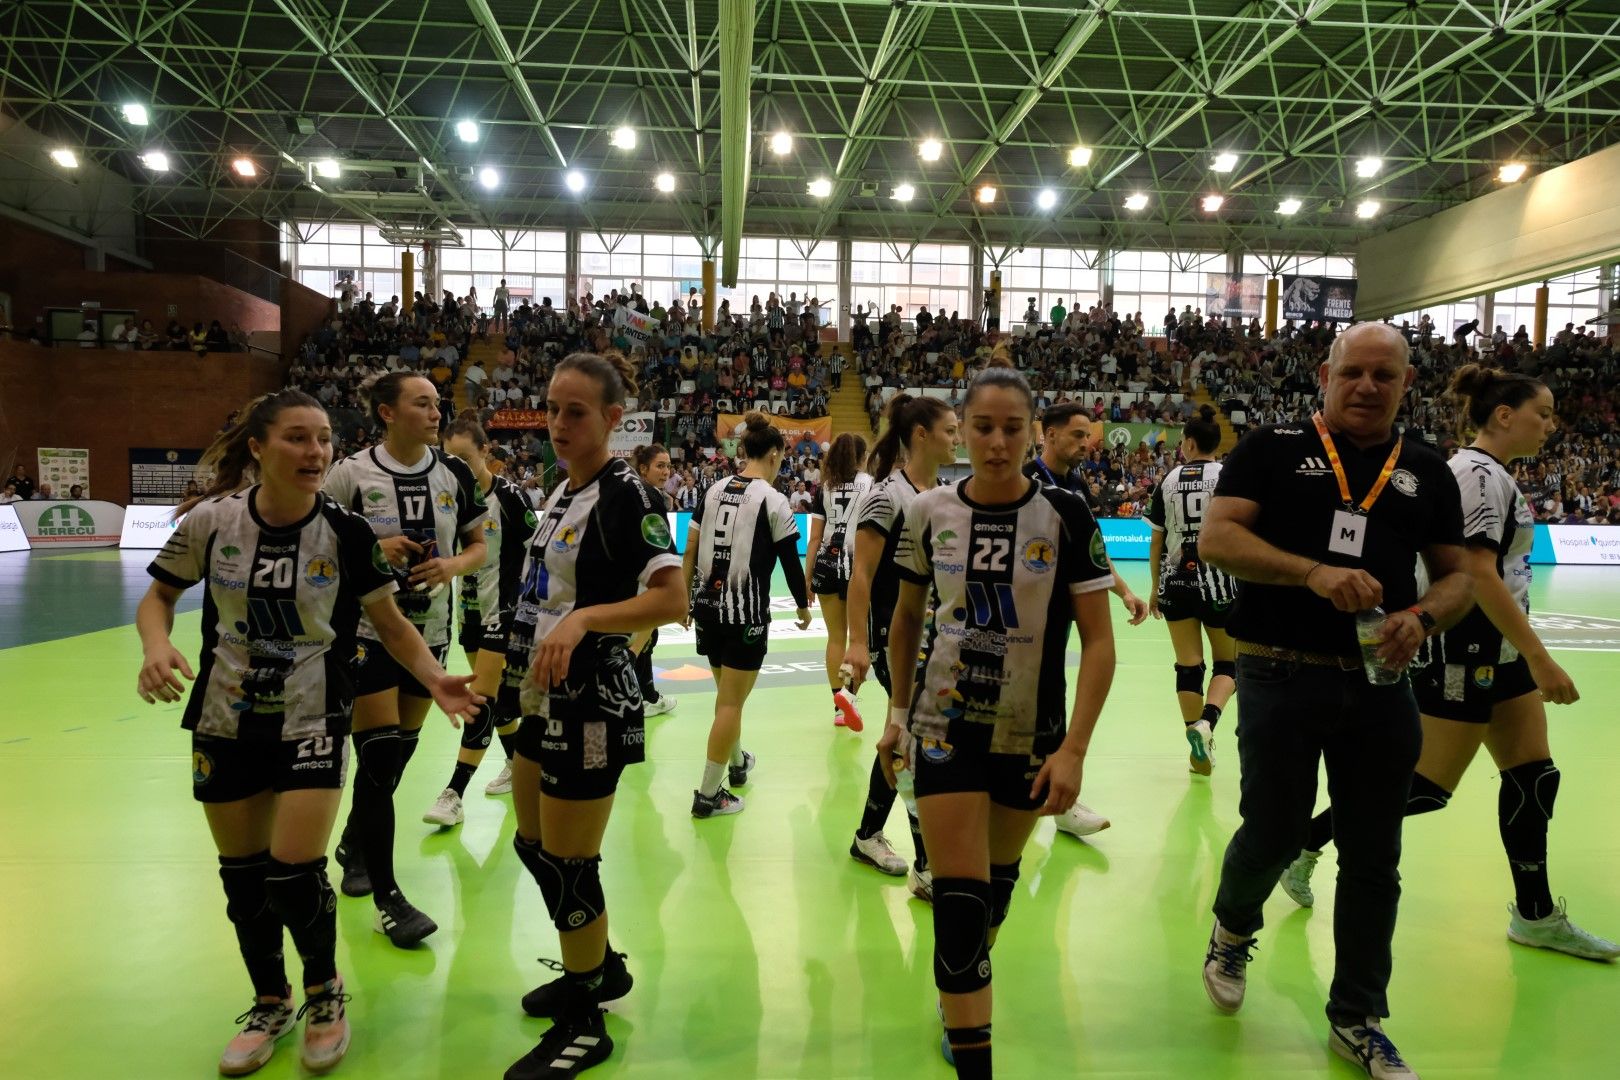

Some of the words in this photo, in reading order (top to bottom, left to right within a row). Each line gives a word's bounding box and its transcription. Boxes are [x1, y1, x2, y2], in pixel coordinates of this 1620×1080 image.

[1324, 307, 1353, 318] PANTERA
[1327, 298, 1351, 309] FRENTE
[403, 495, 427, 521] 17
[829, 491, 860, 525] 57
[1171, 491, 1211, 533] 19
[38, 527, 96, 536] HERECU
[132, 519, 168, 530] Hospital
[714, 504, 738, 547] 9
[1340, 527, 1356, 541] M
[972, 537, 1010, 572] 22
[253, 556, 294, 589] 20
[939, 623, 985, 640] Diputación
[988, 630, 1033, 644] Provincial
